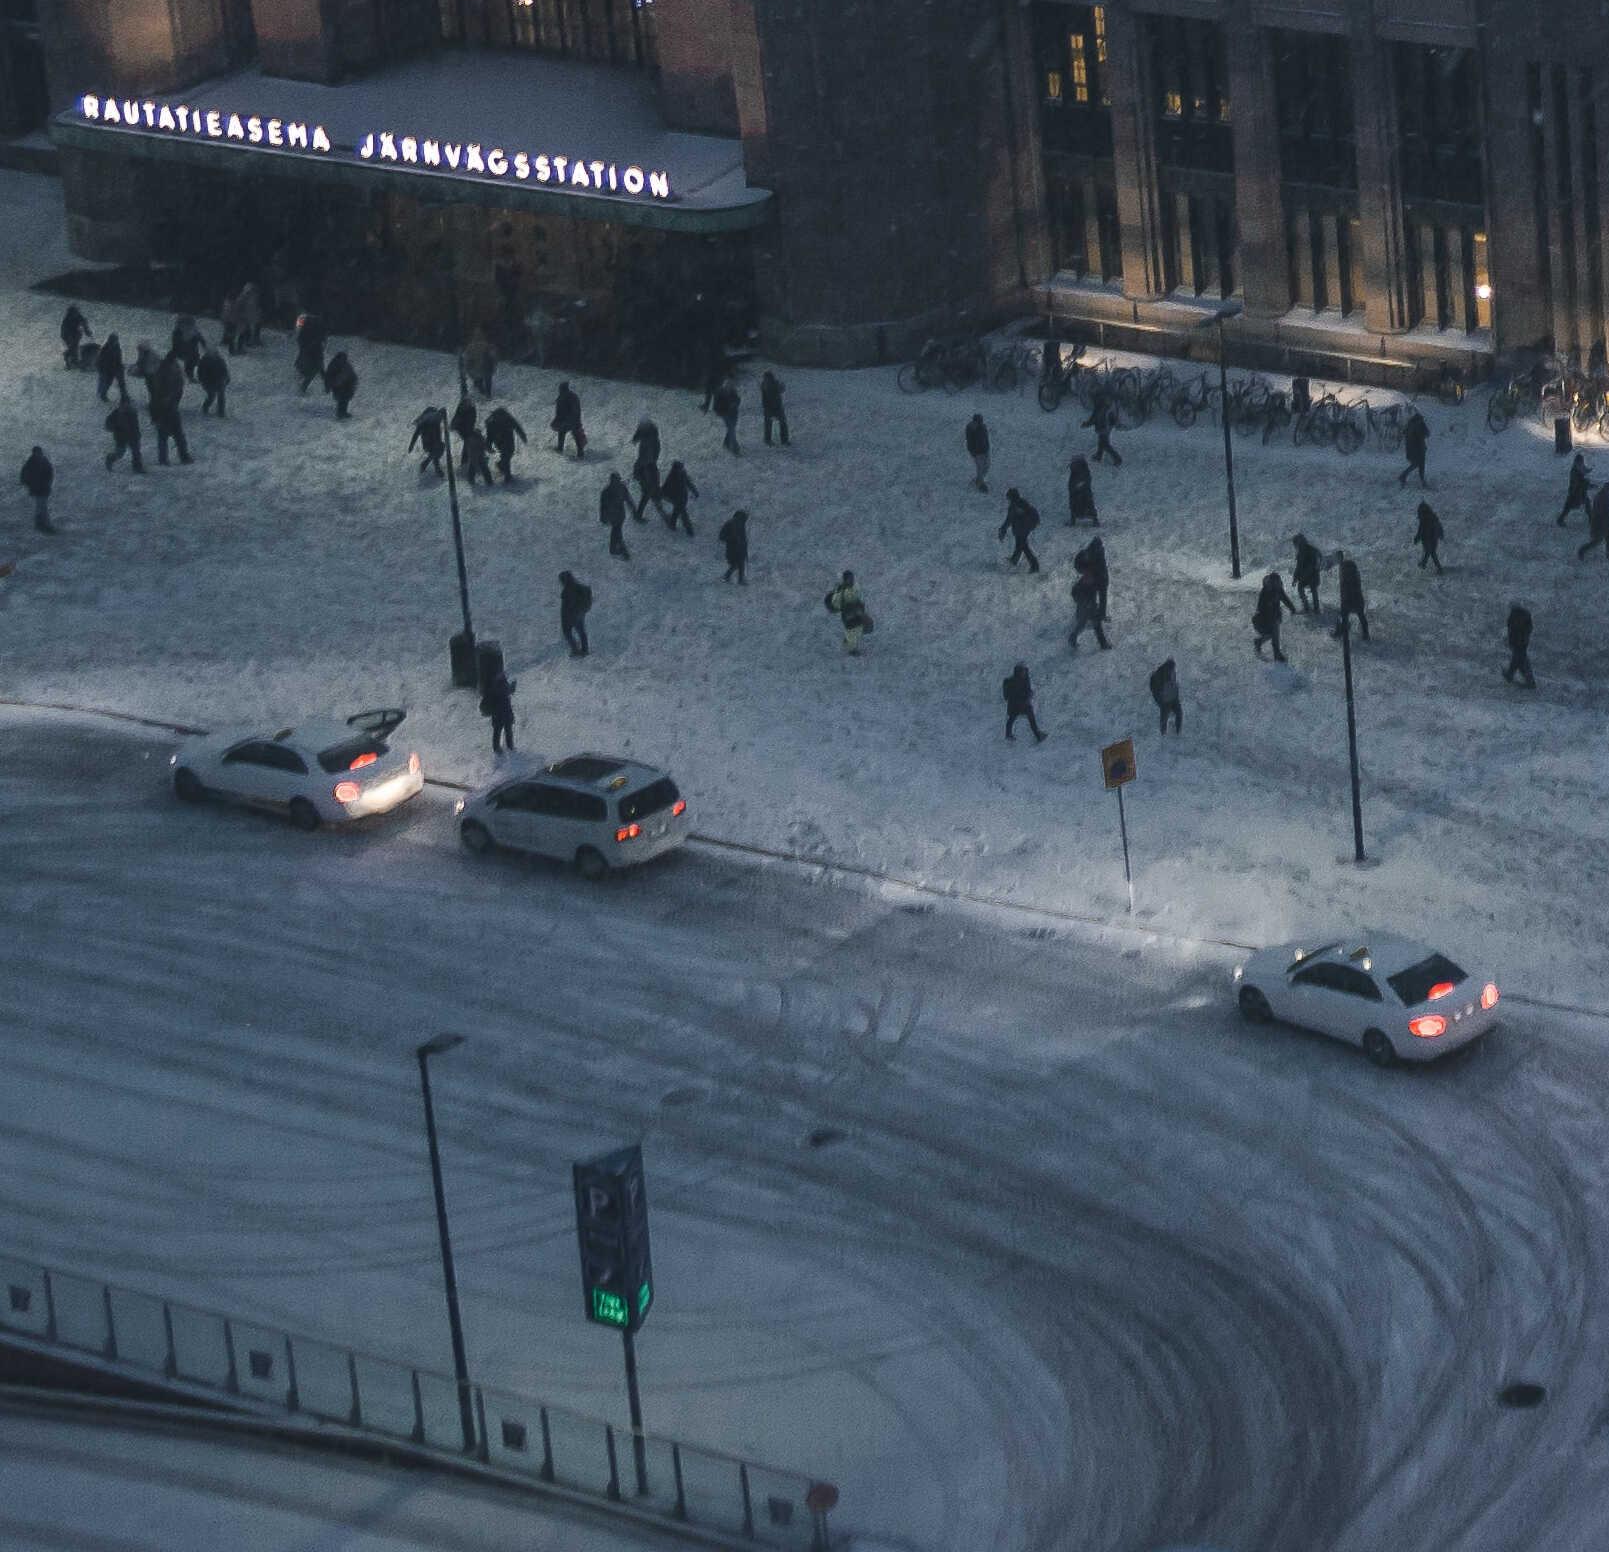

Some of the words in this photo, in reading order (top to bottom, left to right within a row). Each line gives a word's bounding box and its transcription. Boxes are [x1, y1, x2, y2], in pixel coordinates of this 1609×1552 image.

[81, 93, 331, 153] RAUTATIEASEMA
[359, 130, 670, 199] JÄRNVÄGSSTATION
[588, 1185, 610, 1217] P
